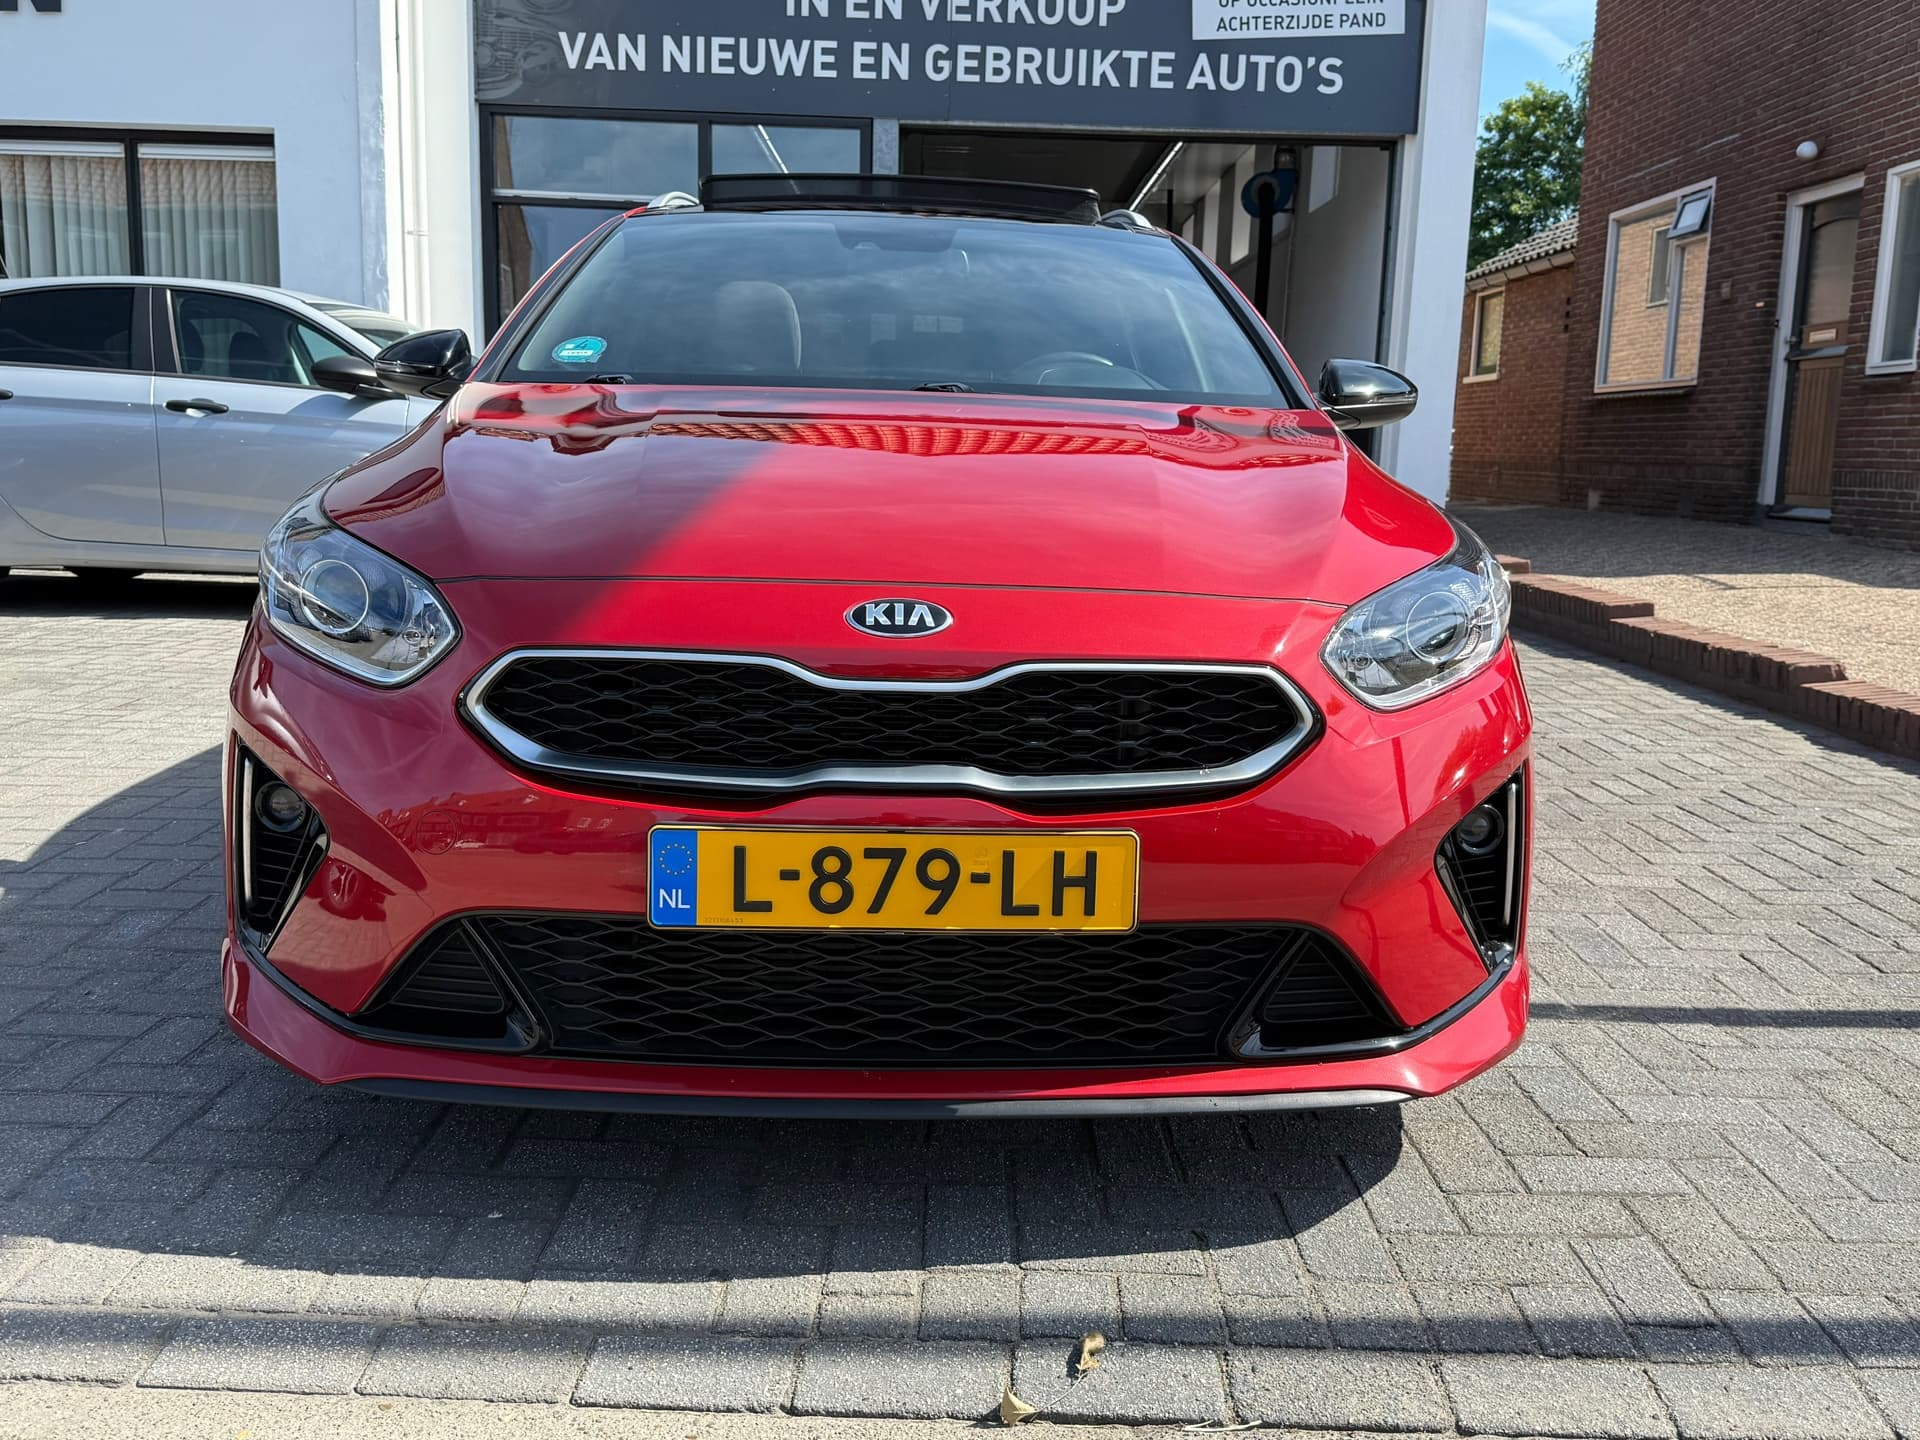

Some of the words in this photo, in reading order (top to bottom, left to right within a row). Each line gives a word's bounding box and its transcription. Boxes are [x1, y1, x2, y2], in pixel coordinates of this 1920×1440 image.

[922, 0, 1125, 26] VERKOOP
[1217, 14, 1333, 31] ACHTERZIJDE
[1340, 13, 1385, 28] PAND
[558, 32, 645, 71] VAN
[663, 35, 837, 77] NIEUWE
[853, 42, 909, 80] EN
[925, 44, 1175, 88] GEBRUIKTE
[865, 603, 936, 627] KIA
[734, 846, 1097, 916] L-879-LH
[660, 889, 690, 908] NL
